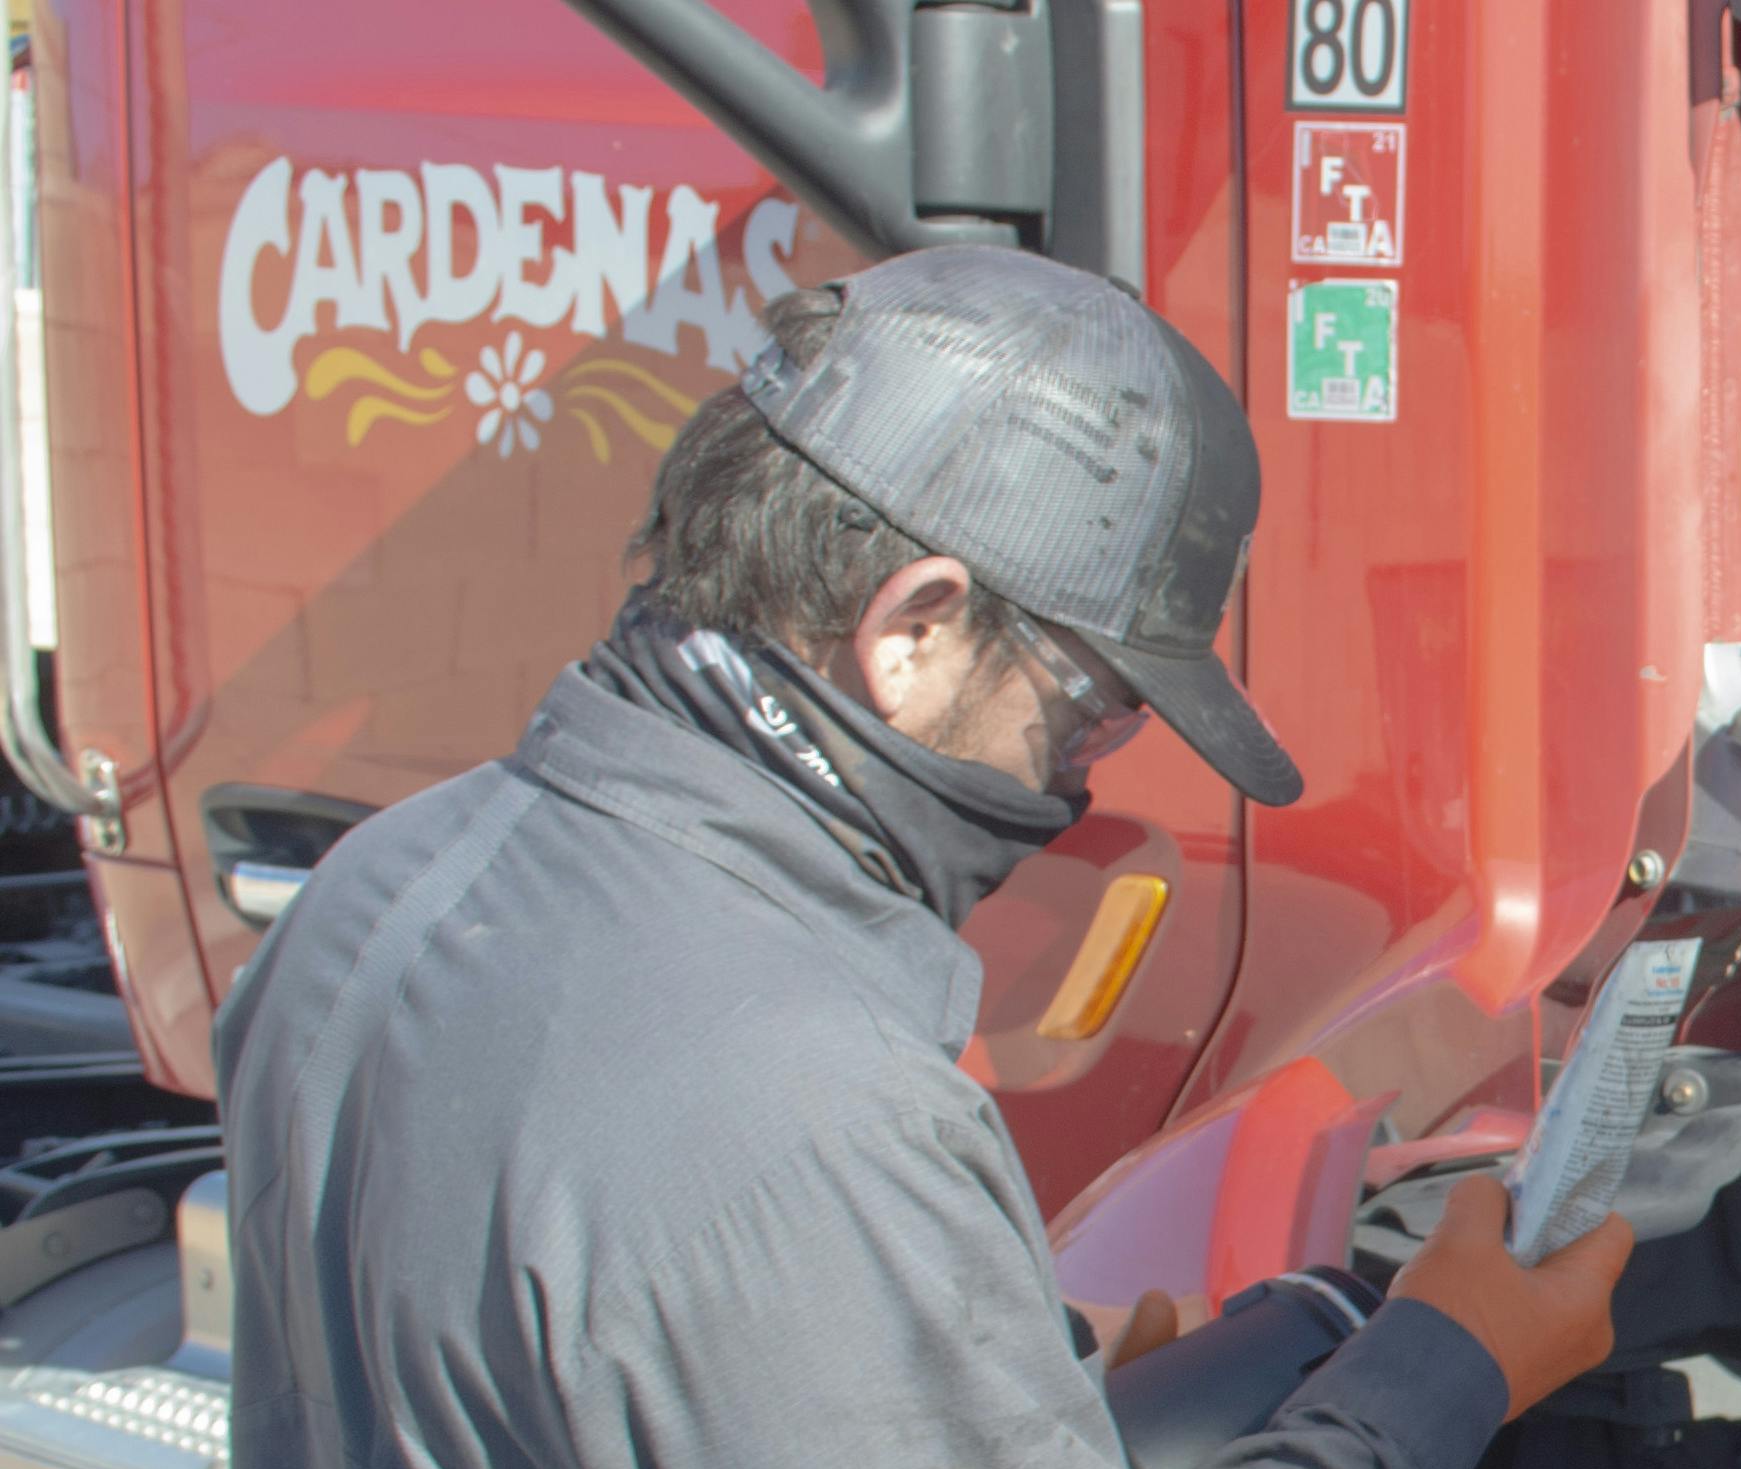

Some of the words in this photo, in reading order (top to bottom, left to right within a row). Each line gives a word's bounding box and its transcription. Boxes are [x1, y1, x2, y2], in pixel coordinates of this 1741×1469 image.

[1301, 0, 1395, 97] 80
[1372, 131, 1397, 152] 21
[1298, 235, 1327, 254] CA
[218, 154, 801, 418] CARDENAS
